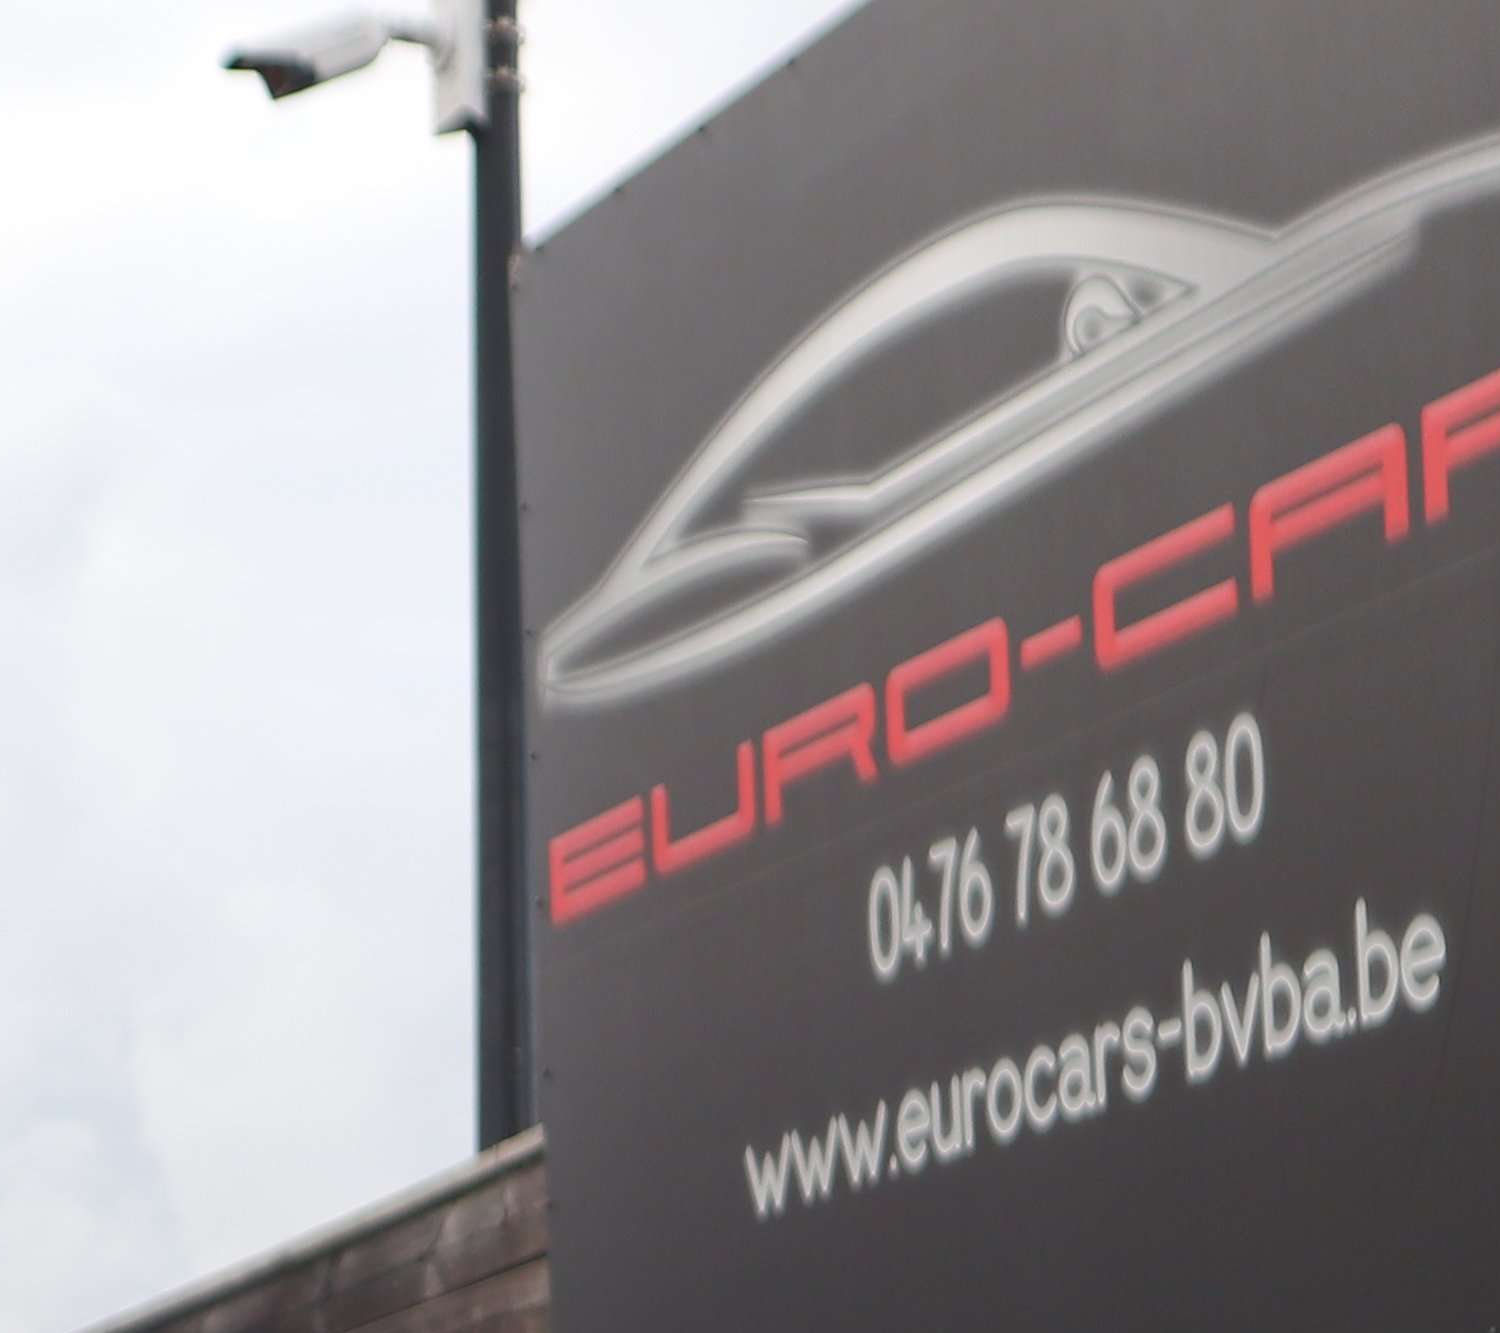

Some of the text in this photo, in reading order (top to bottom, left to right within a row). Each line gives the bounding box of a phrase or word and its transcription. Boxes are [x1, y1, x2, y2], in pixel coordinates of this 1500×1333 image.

[867, 711, 1266, 981] 0476 78 68 80
[744, 898, 1447, 1216] www.eurocars-bvba.be
